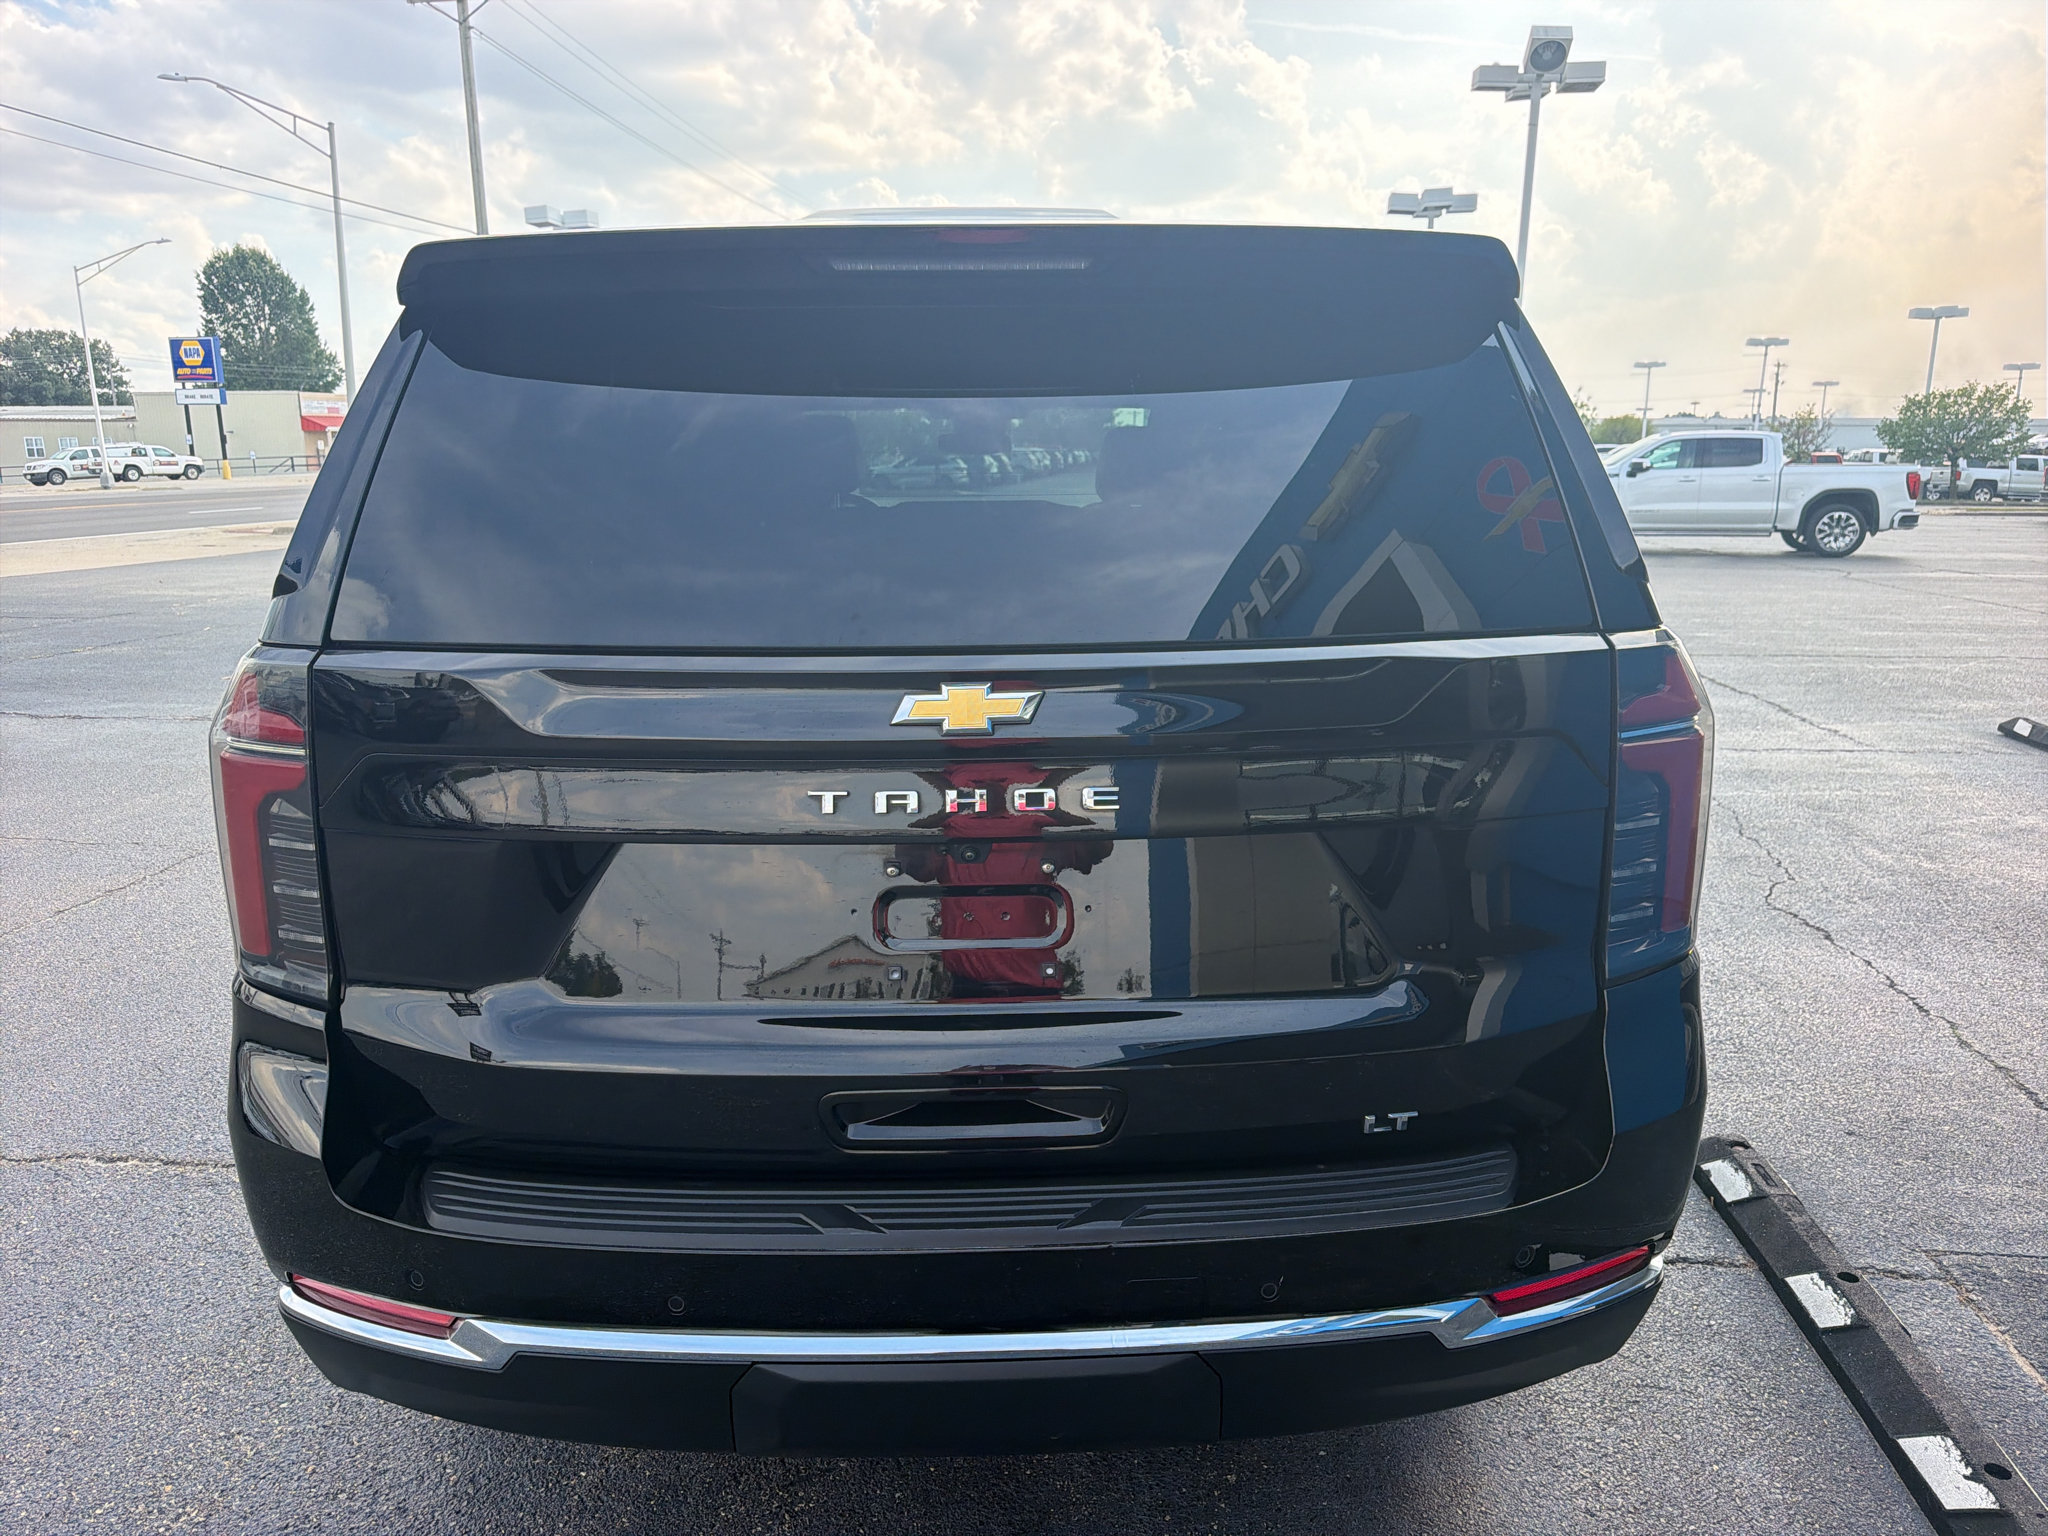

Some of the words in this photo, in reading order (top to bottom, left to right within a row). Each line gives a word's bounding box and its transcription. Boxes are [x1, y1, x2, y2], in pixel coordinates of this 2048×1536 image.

[183, 347, 201, 359] NAPA
[808, 787, 1120, 814] TAHOE
[1364, 1111, 1419, 1133] LT
